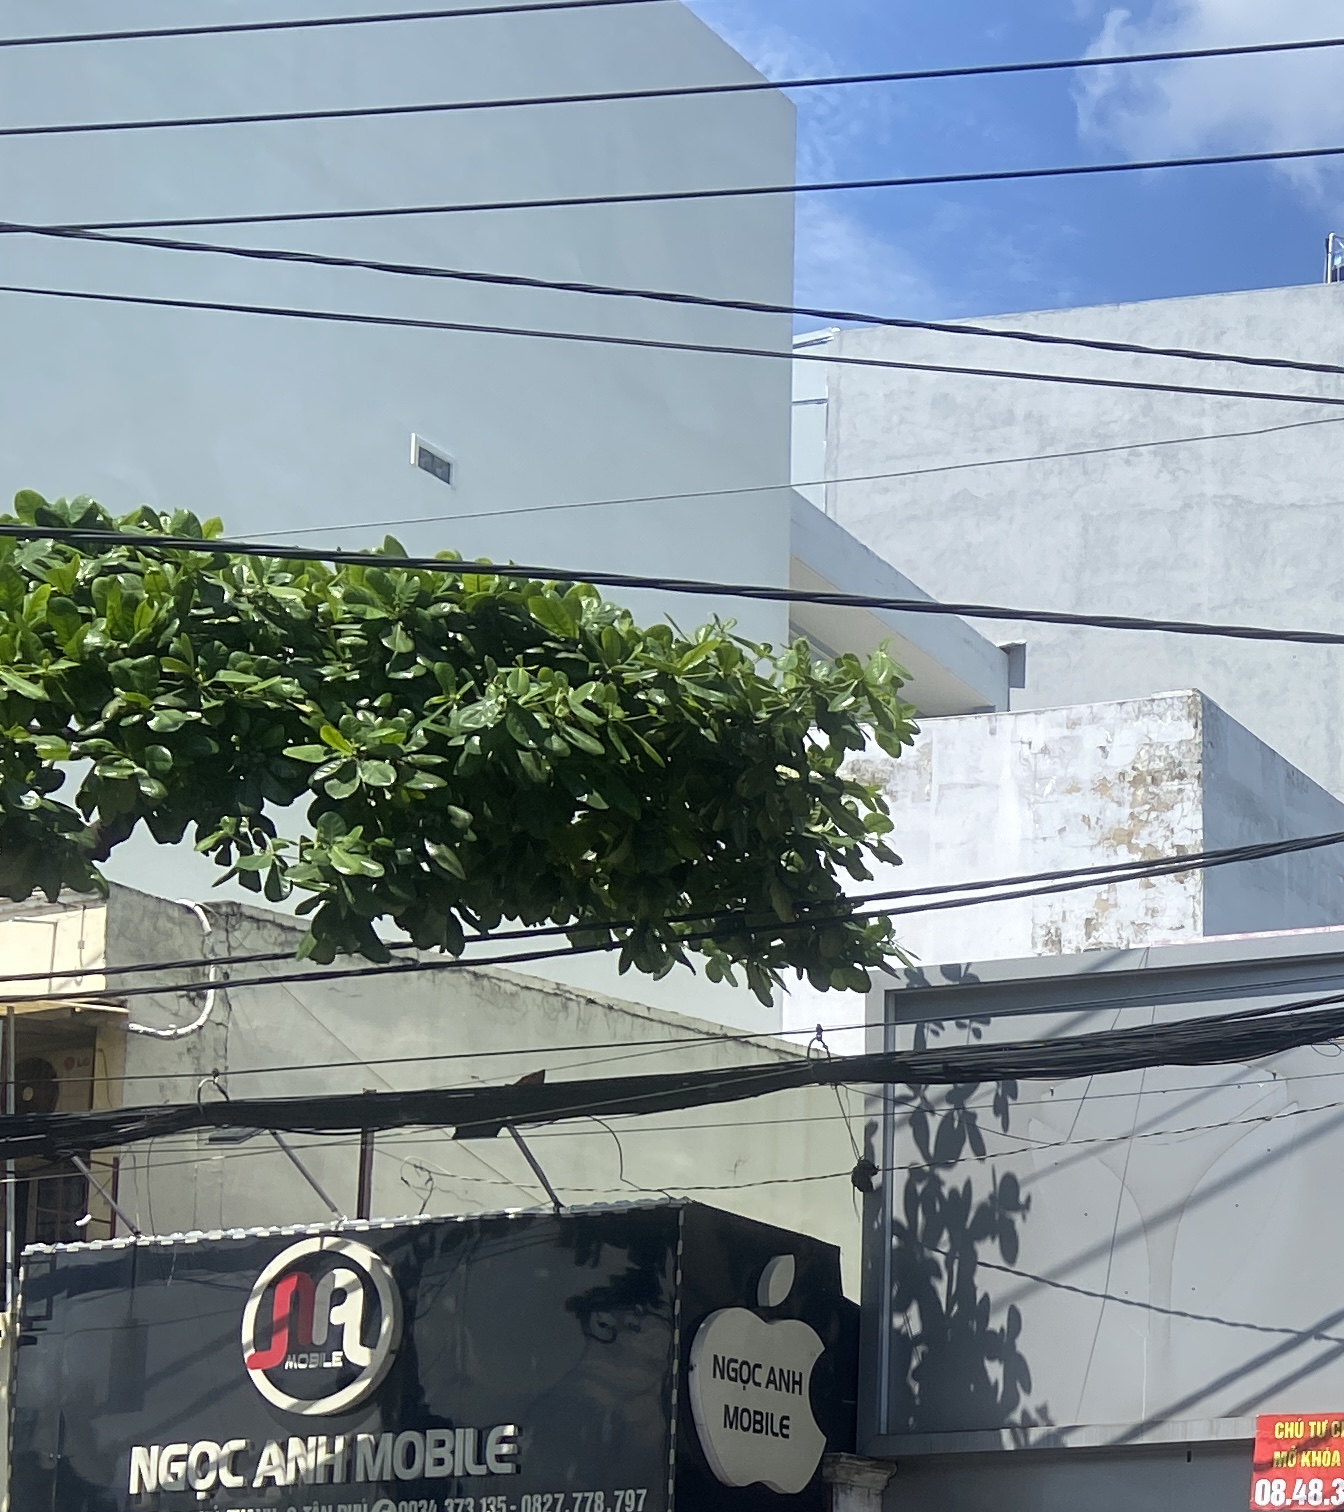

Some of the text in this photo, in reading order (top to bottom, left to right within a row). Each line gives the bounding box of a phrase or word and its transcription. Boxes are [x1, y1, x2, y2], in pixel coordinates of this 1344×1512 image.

[285, 1351, 343, 1370] MOBILE
[712, 1353, 803, 1396] NGỌC ANH
[723, 1404, 791, 1440] MOBILE
[128, 1423, 520, 1500] NGỌC ANH MOBILE
[1273, 1445, 1297, 1468] MỞ
[1300, 1446, 1341, 1467] KHÓA
